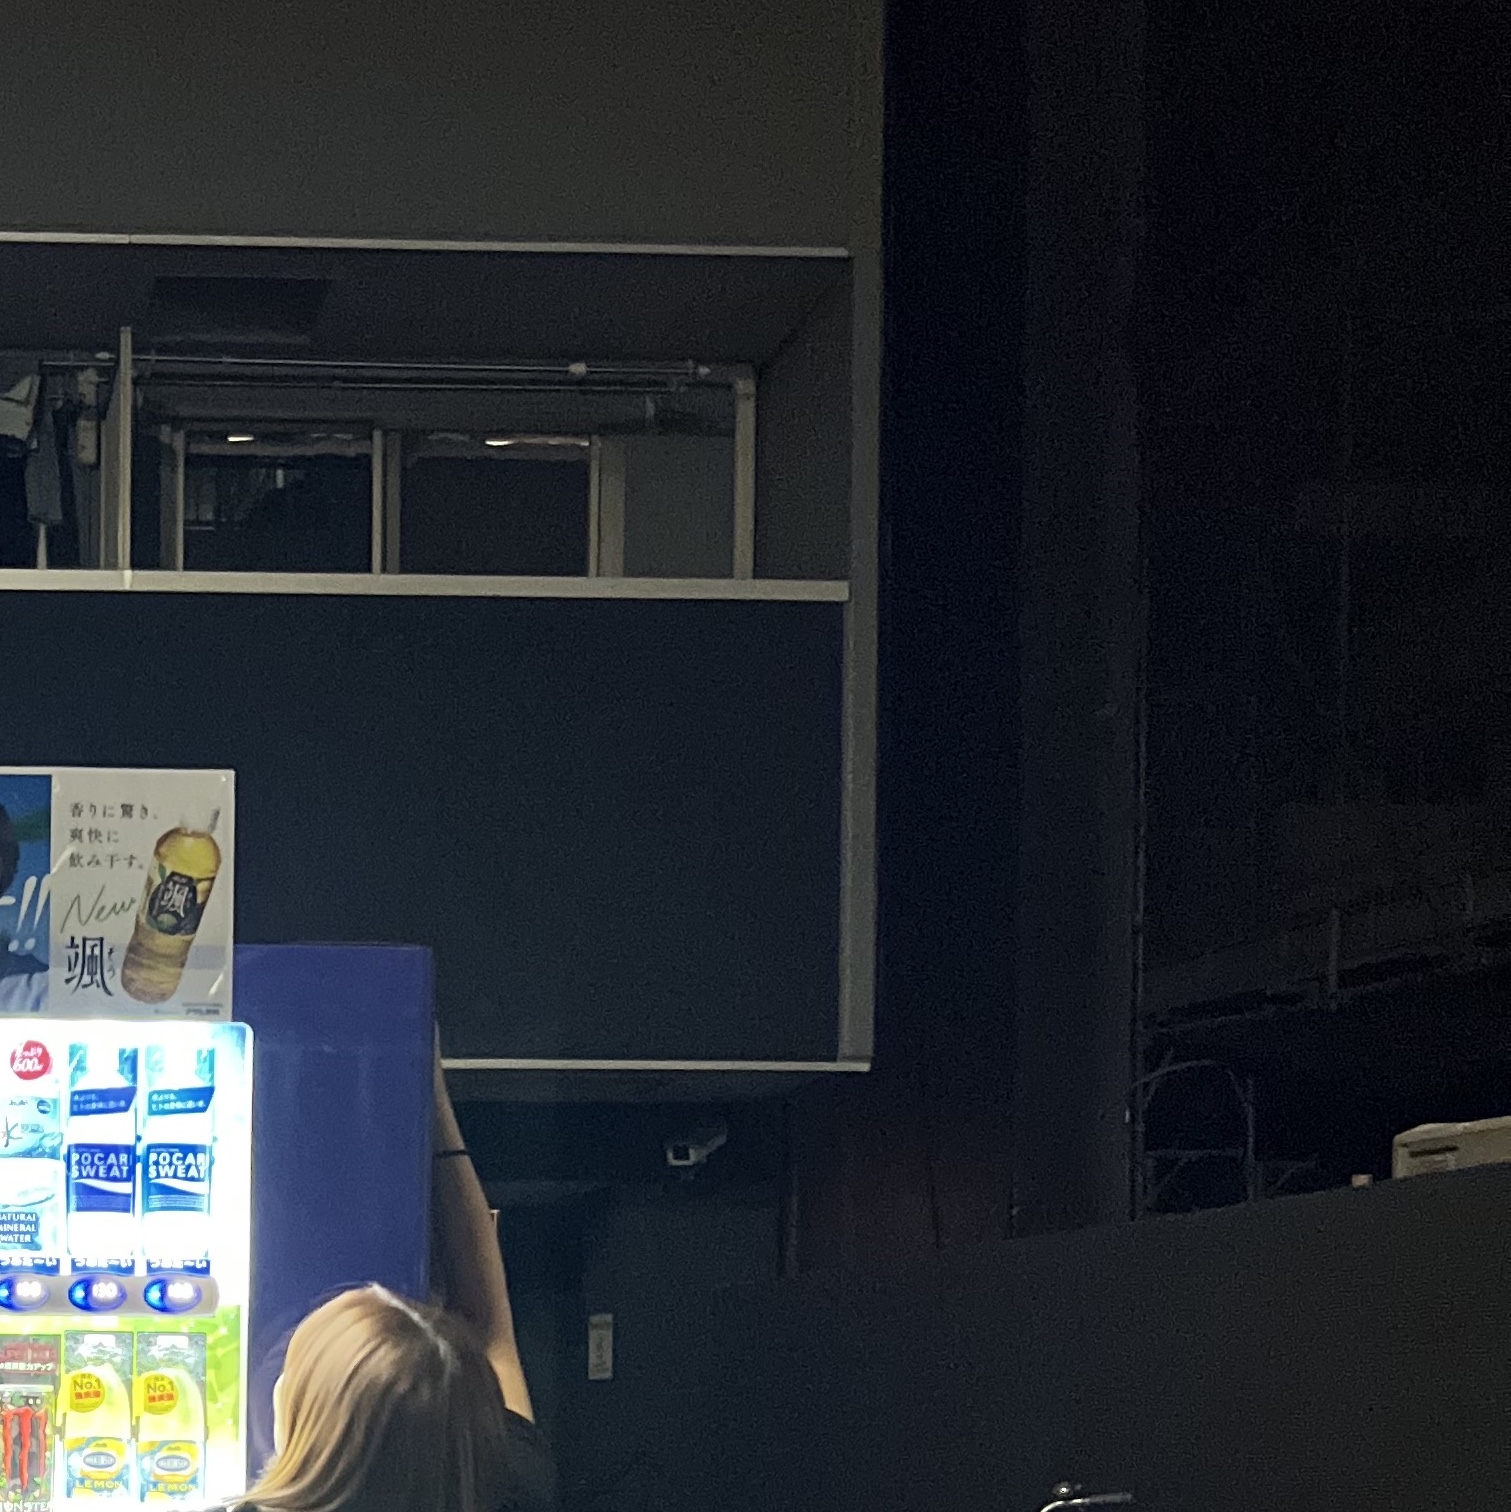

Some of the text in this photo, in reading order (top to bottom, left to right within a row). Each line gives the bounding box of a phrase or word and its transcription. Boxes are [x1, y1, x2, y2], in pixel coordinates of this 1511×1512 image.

[69, 803, 159, 820] 香りに驚き。
[68, 828, 120, 844] 爽快に
[68, 853, 144, 870] 飲み干す。
[59, 884, 137, 935] New
[64, 936, 114, 998] 颯
[148, 1152, 208, 1166] POCAR
[71, 1165, 129, 1179] SWEAT
[148, 1165, 208, 1179] SWEAT
[0, 1233, 32, 1244] WATER
[73, 1378, 101, 1391] No.1
[146, 1382, 174, 1395] No.1
